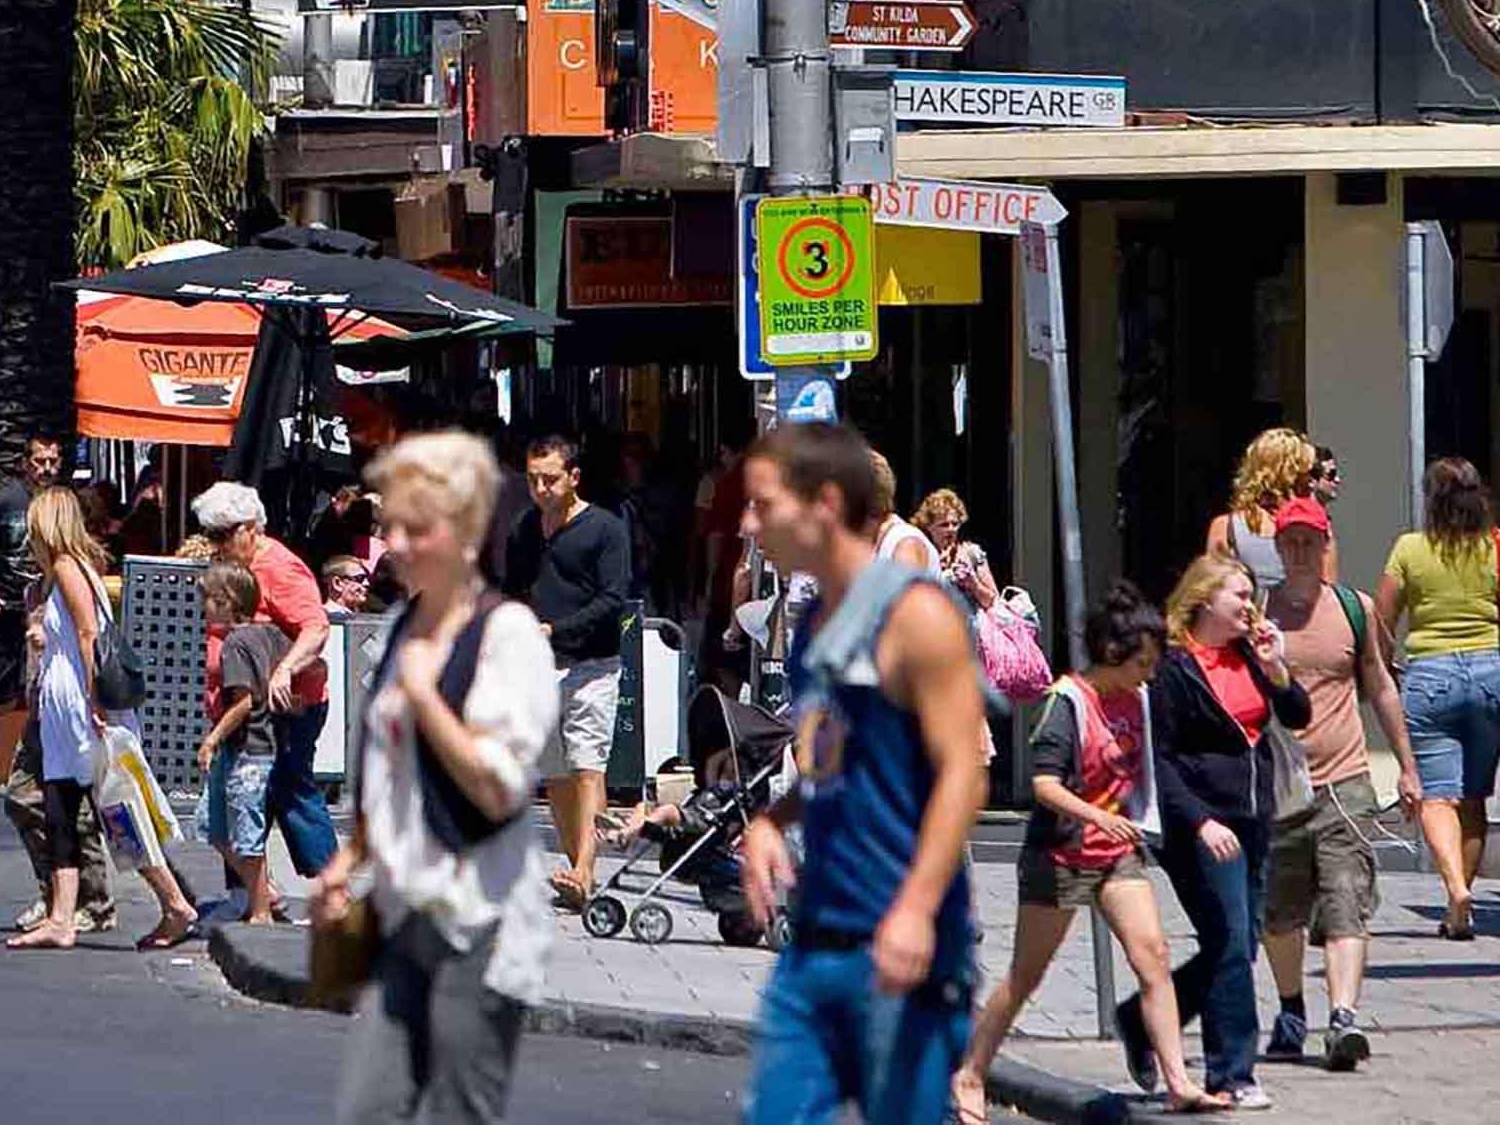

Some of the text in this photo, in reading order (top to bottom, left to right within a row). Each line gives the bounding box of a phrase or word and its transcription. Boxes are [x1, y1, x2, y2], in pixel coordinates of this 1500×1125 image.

[873, 6, 918, 22] ST KILDA
[845, 24, 946, 43] COMMUNITY GARDEN
[894, 85, 1084, 118] HAKESPEARE
[845, 181, 1040, 225] OST OFFICE
[804, 241, 828, 278] 3
[771, 299, 865, 316] SMILES PER
[772, 315, 865, 332] HOUR ZONE
[139, 348, 250, 374] GIGANTE
